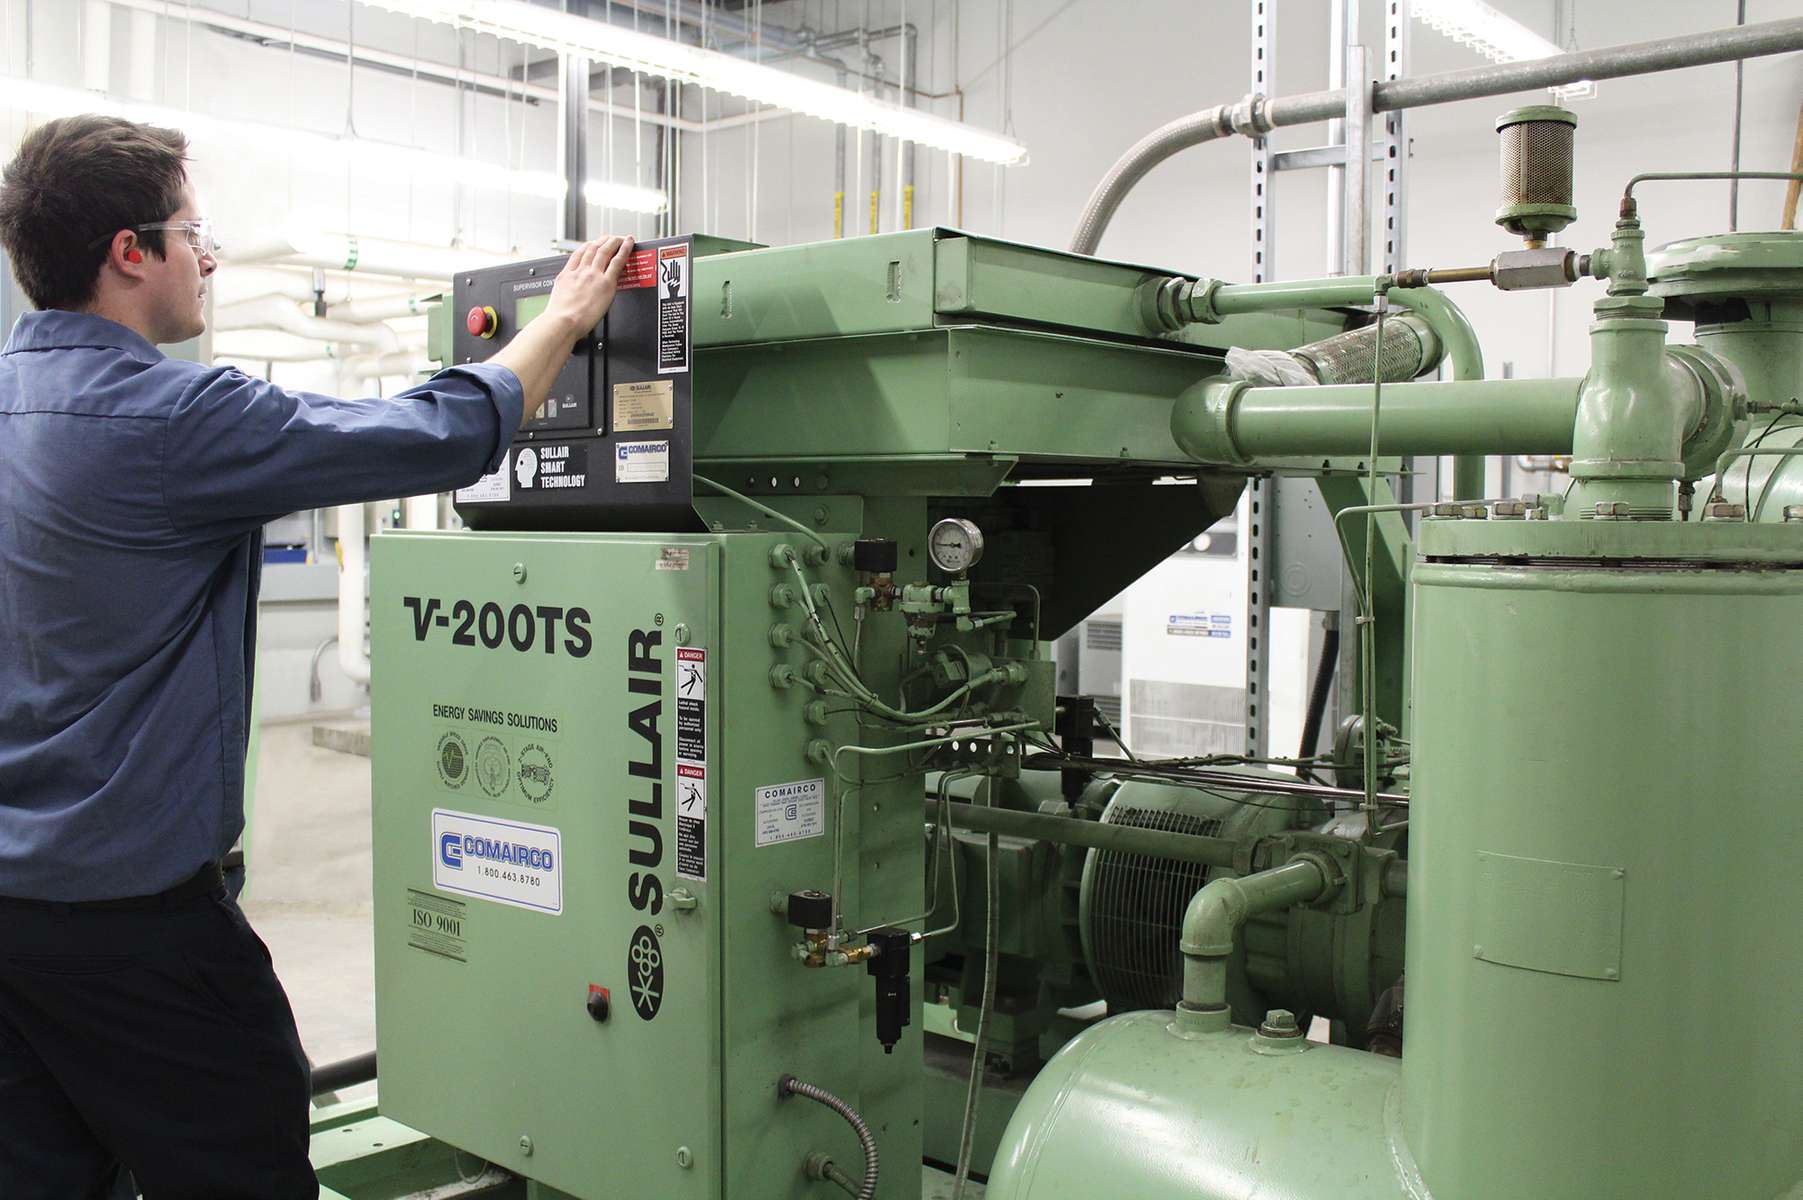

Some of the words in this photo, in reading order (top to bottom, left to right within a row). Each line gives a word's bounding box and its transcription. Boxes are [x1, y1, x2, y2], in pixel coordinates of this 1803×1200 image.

[513, 281, 542, 292] SUPERVISOR
[540, 446, 570, 459] SULLAIR
[628, 443, 667, 454] COMAIRCO
[540, 461, 565, 474] SMART
[540, 474, 586, 489] TECHNOLOGY
[403, 596, 592, 658] V-200TS
[684, 651, 703, 659] DANGER
[433, 704, 465, 720] ENERGY
[468, 708, 504, 725] SAVINGS
[507, 712, 558, 733] SOLUTIONS
[684, 768, 703, 776] DANGER
[765, 784, 816, 799] COMAIRCO
[463, 834, 555, 872] COMAIRCO
[477, 866, 541, 887] 1.800.463.8780
[413, 908, 432, 928] ISO
[436, 915, 460, 937] 9001
